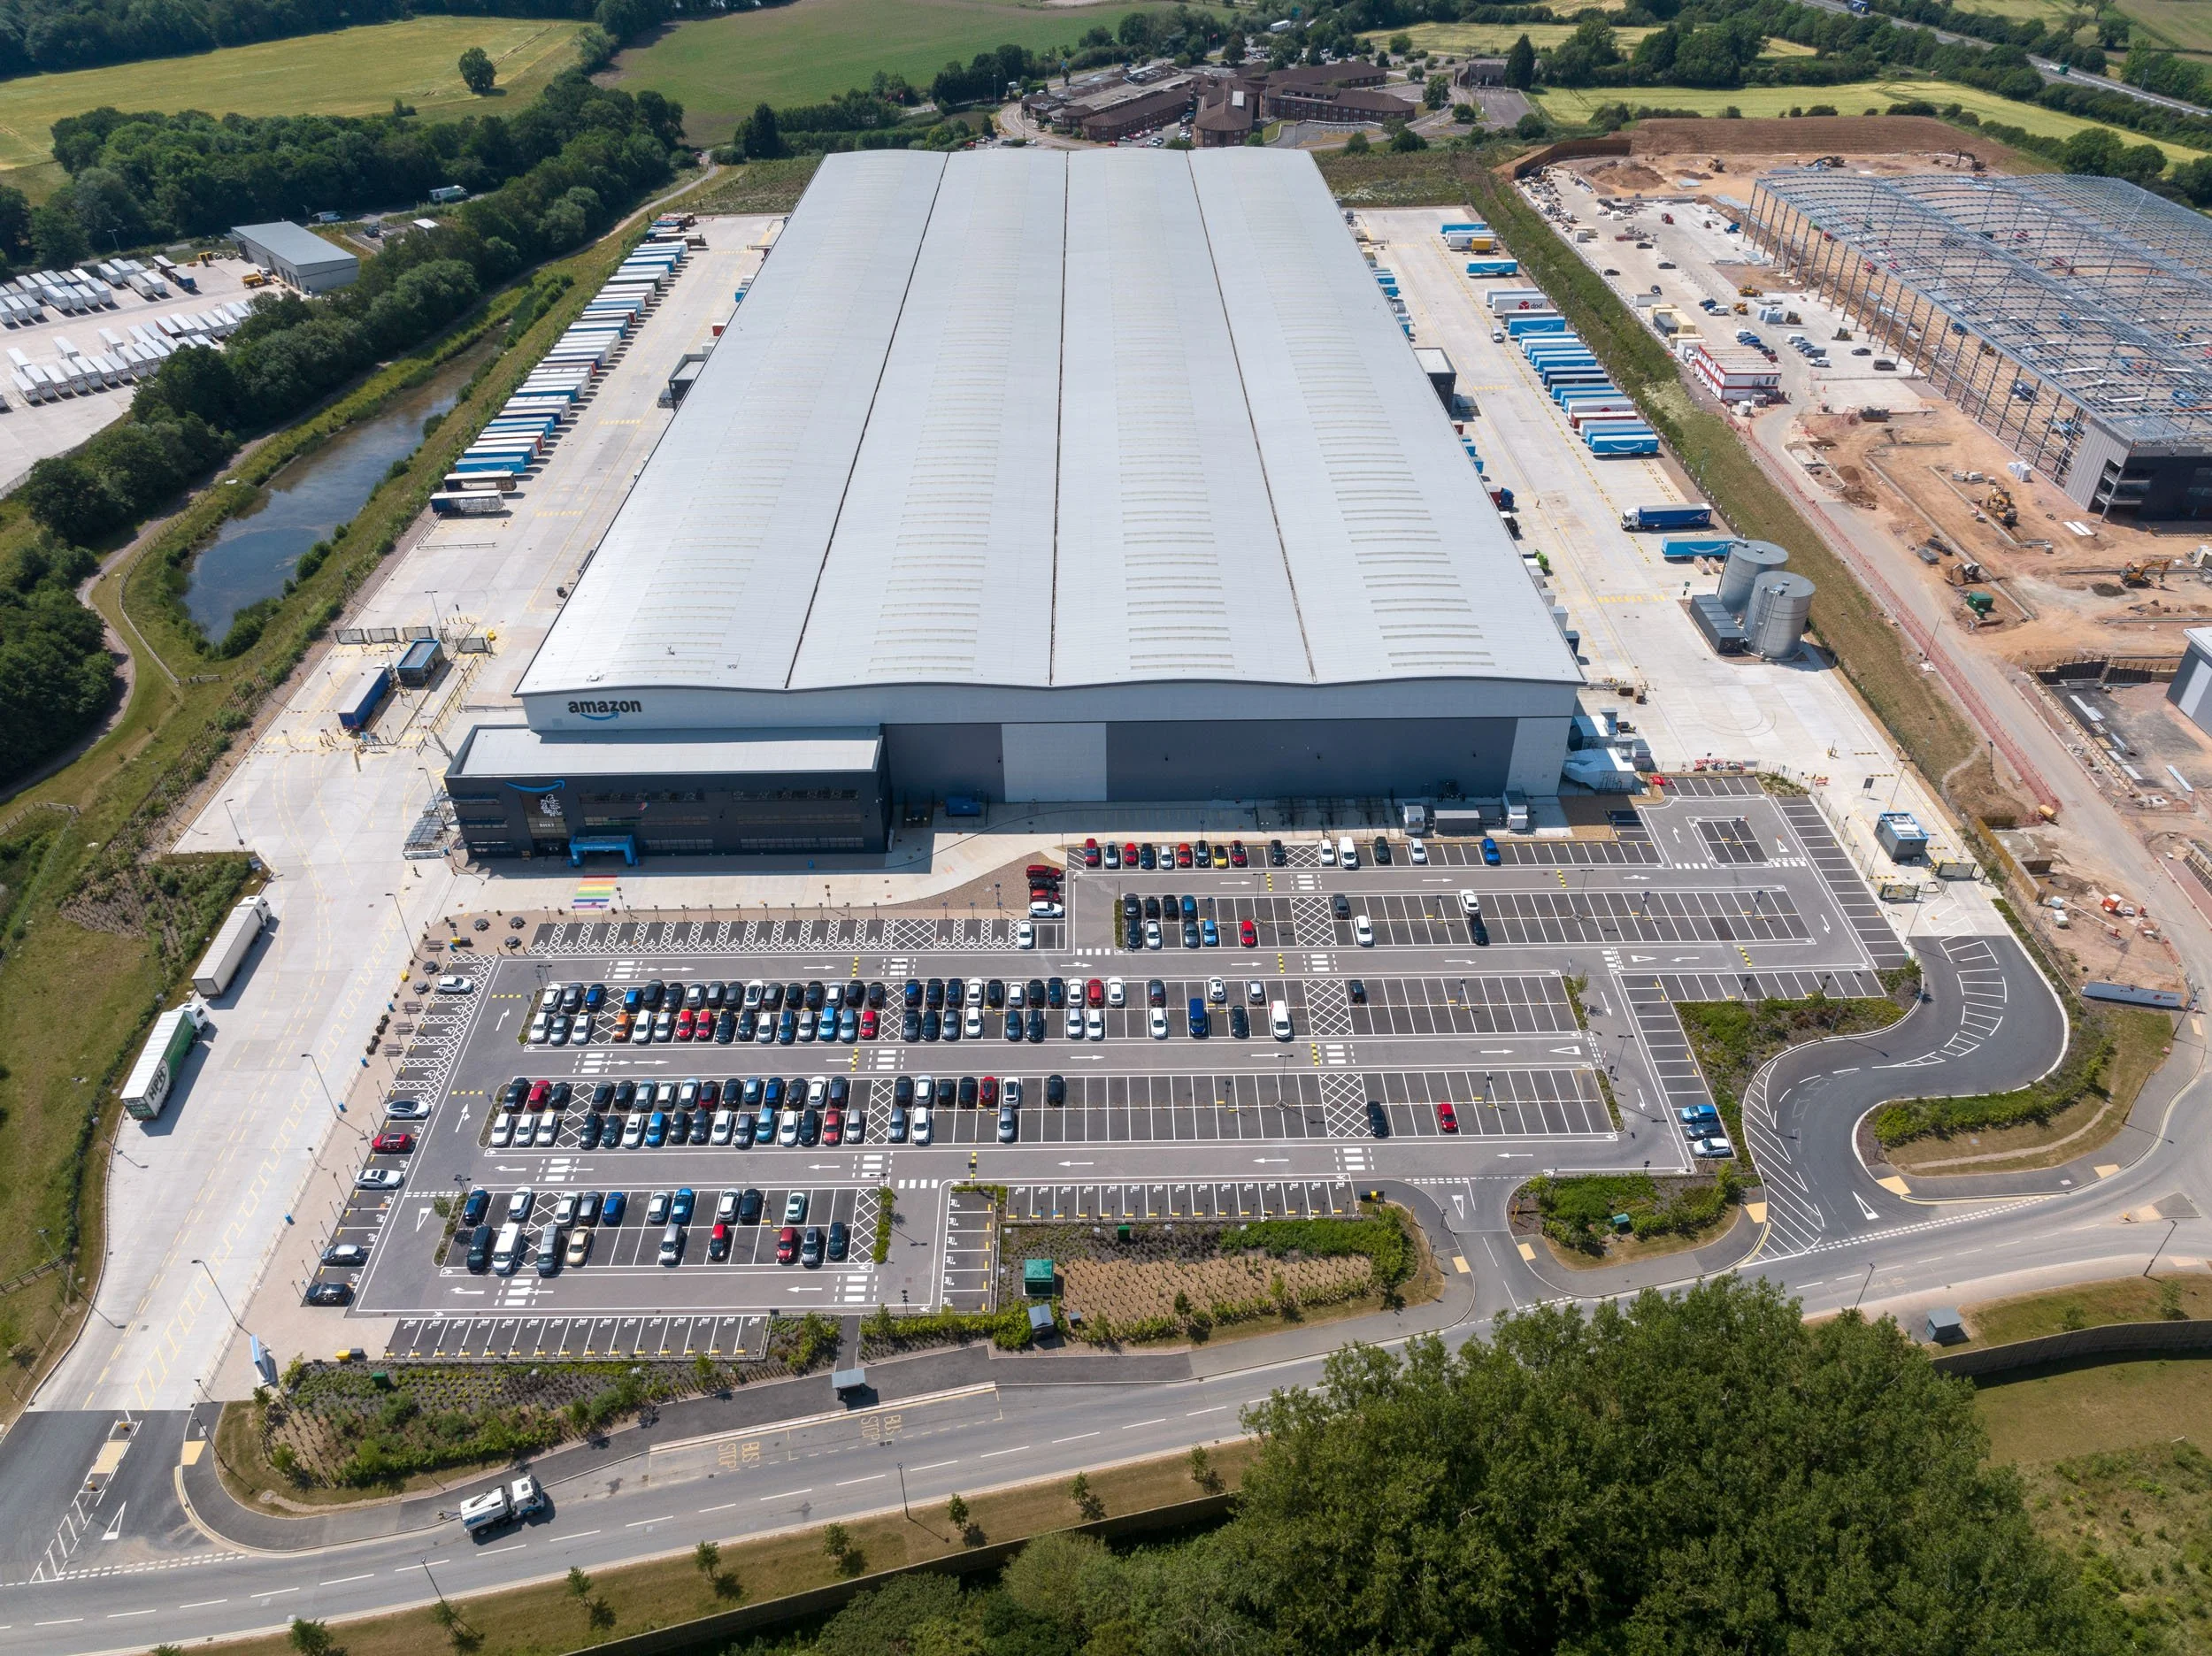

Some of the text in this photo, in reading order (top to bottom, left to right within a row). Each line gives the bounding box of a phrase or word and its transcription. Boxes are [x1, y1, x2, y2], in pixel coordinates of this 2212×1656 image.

[568, 701, 641, 713] amazon
[149, 1070, 166, 1100] HPH
[861, 1415, 880, 1440] STOP
[884, 1415, 902, 1435] BUS
[718, 1443, 736, 1468] STOP
[741, 1442, 760, 1462] BUS
